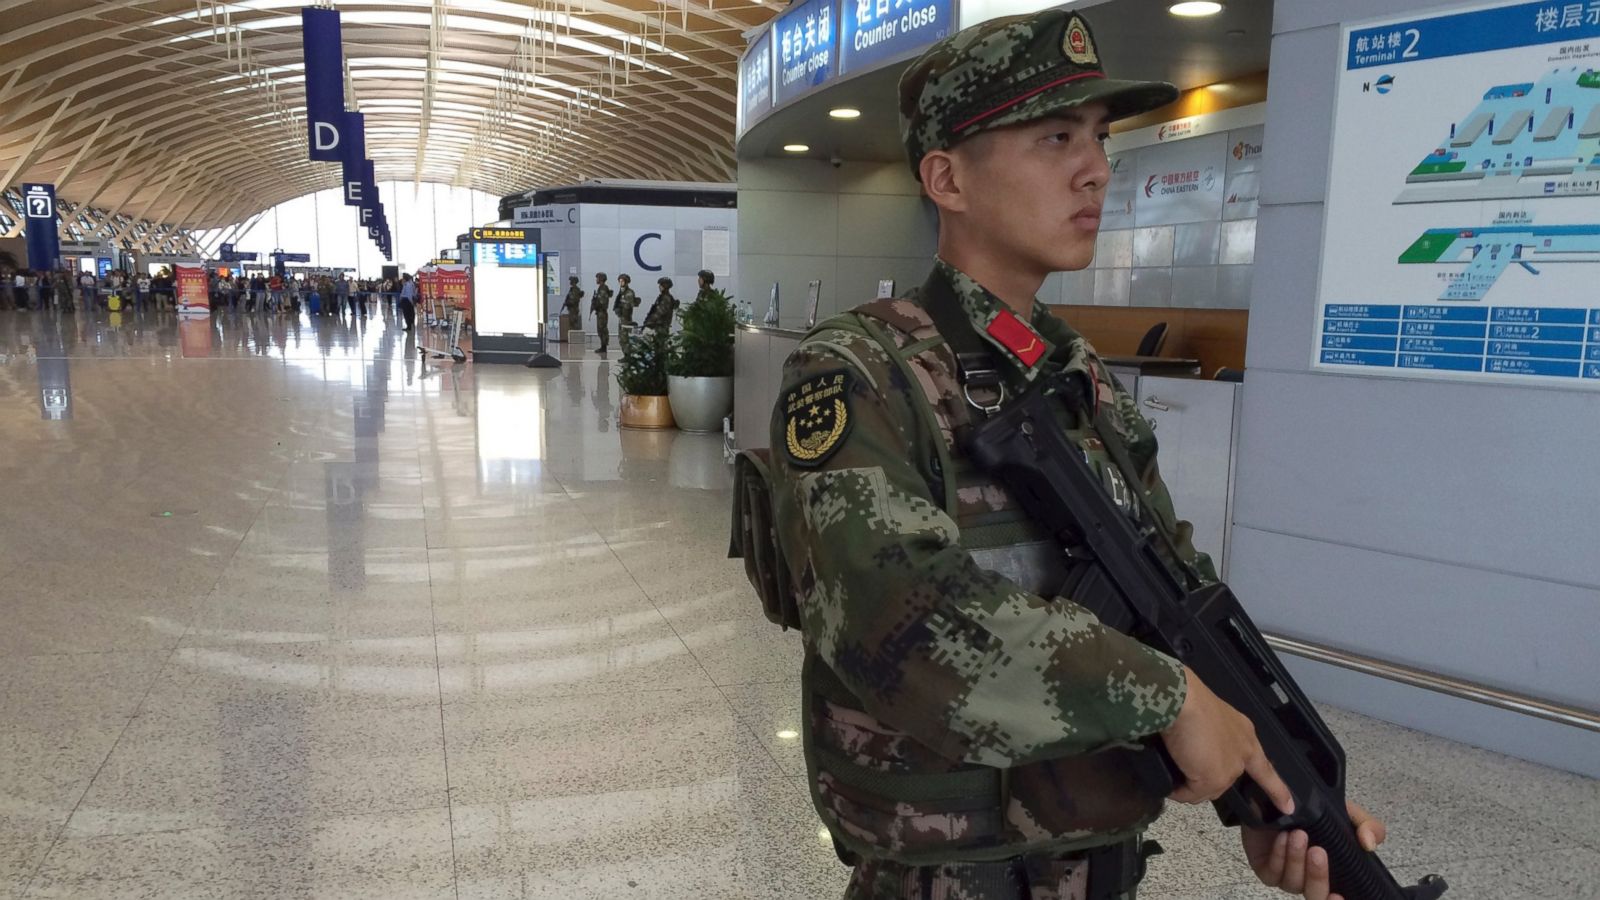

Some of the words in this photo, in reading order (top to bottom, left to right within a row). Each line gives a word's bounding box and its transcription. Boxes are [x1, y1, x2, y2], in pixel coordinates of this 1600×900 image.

[856, 0, 913, 26] 柜台
[782, 6, 831, 65] 柜台关闭
[854, 19, 898, 51] Counter
[900, 4, 937, 33] close
[1355, 31, 1401, 53] 航站楼
[1402, 28, 1420, 58] 2
[1355, 50, 1396, 65] Terminal
[782, 61, 807, 86] Counter
[808, 50, 829, 72] close
[1363, 82, 1370, 93] N
[314, 121, 340, 151] D
[348, 181, 362, 201] E
[1161, 186, 1176, 195] CHINA
[1176, 184, 1199, 193] EASTERN
[362, 209, 373, 223] F
[567, 207, 576, 224] C
[473, 229, 482, 240] C
[634, 232, 662, 272] C
[1534, 309, 1540, 322] 1
[1531, 326, 1540, 340] 2
